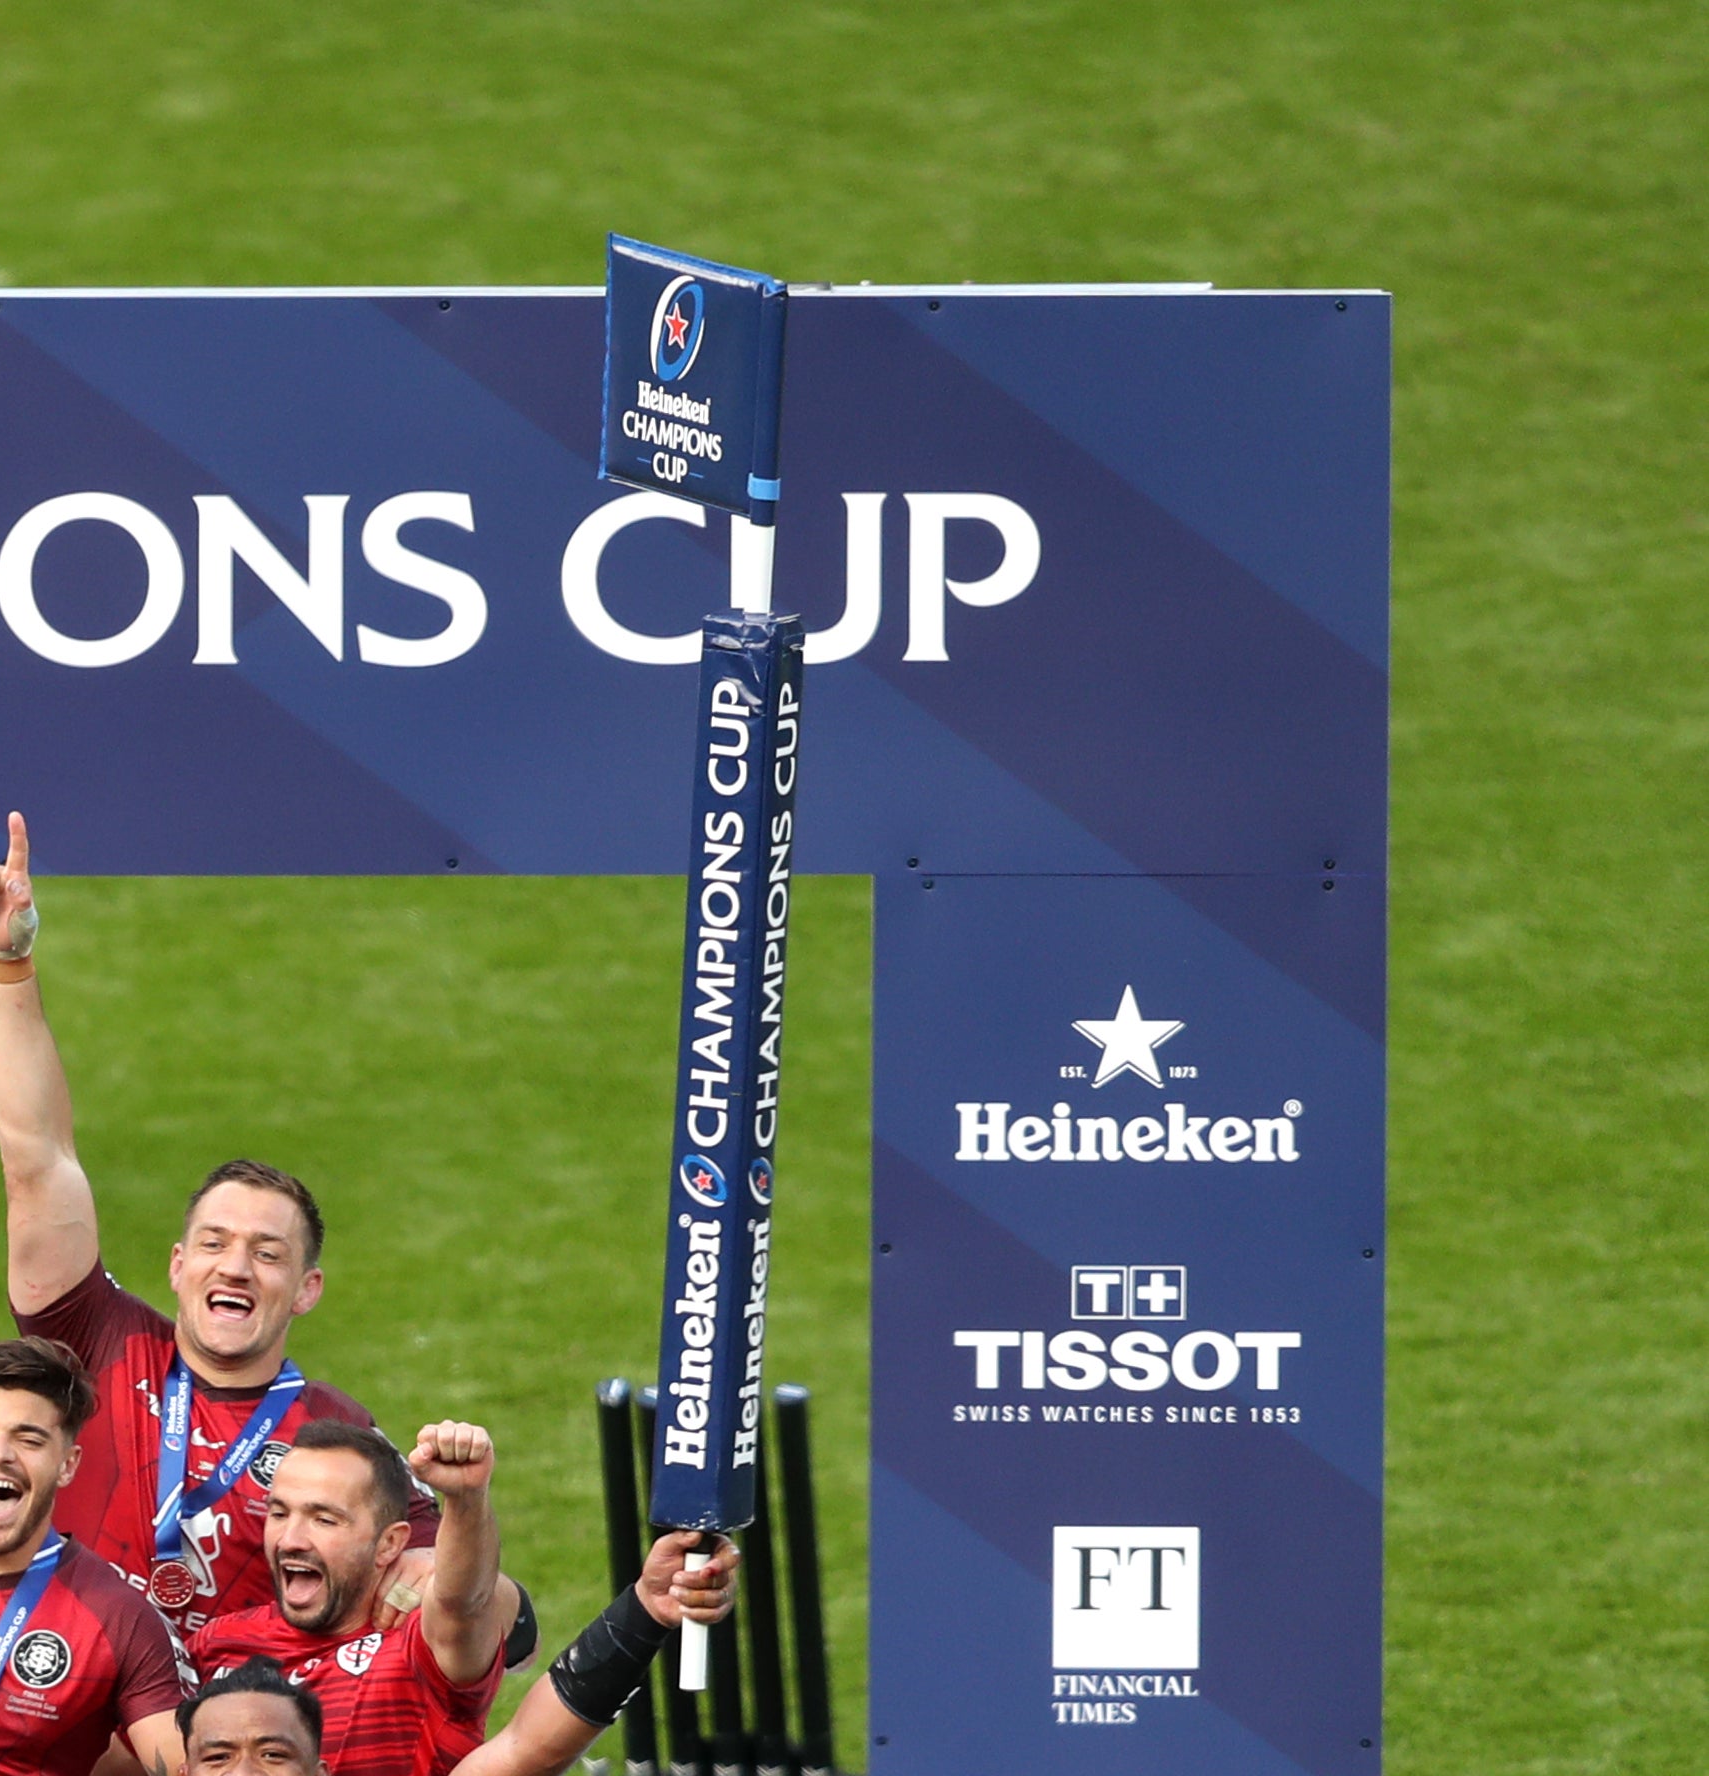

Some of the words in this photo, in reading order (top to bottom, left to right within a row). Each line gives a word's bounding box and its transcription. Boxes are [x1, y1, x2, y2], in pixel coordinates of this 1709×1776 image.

[637, 380, 711, 426] Heineken
[622, 410, 723, 463] CHAMPIONS
[652, 452, 688, 484] CUP
[707, 679, 750, 797] CUP
[773, 681, 801, 797] CUP
[687, 810, 746, 1148] CHAMPIONS
[754, 809, 793, 1148] CHAMPIONS
[1060, 1067, 1088, 1079] EST.
[1170, 1067, 1198, 1080] 1873
[954, 1103, 1302, 1164] Heineken
[664, 1217, 723, 1471] Heineken
[732, 1217, 771, 1470] Heineken
[954, 1331, 1303, 1393] TISSOT
[954, 1405, 1031, 1424] SWISS
[1042, 1406, 1155, 1424] WATCHES
[1166, 1406, 1238, 1425] SINCE
[1250, 1407, 1302, 1425] 1853
[1071, 1546, 1186, 1611] FT
[1052, 1702, 1138, 1724] TIMES
[1053, 1674, 1200, 1698] FINANCIAL
